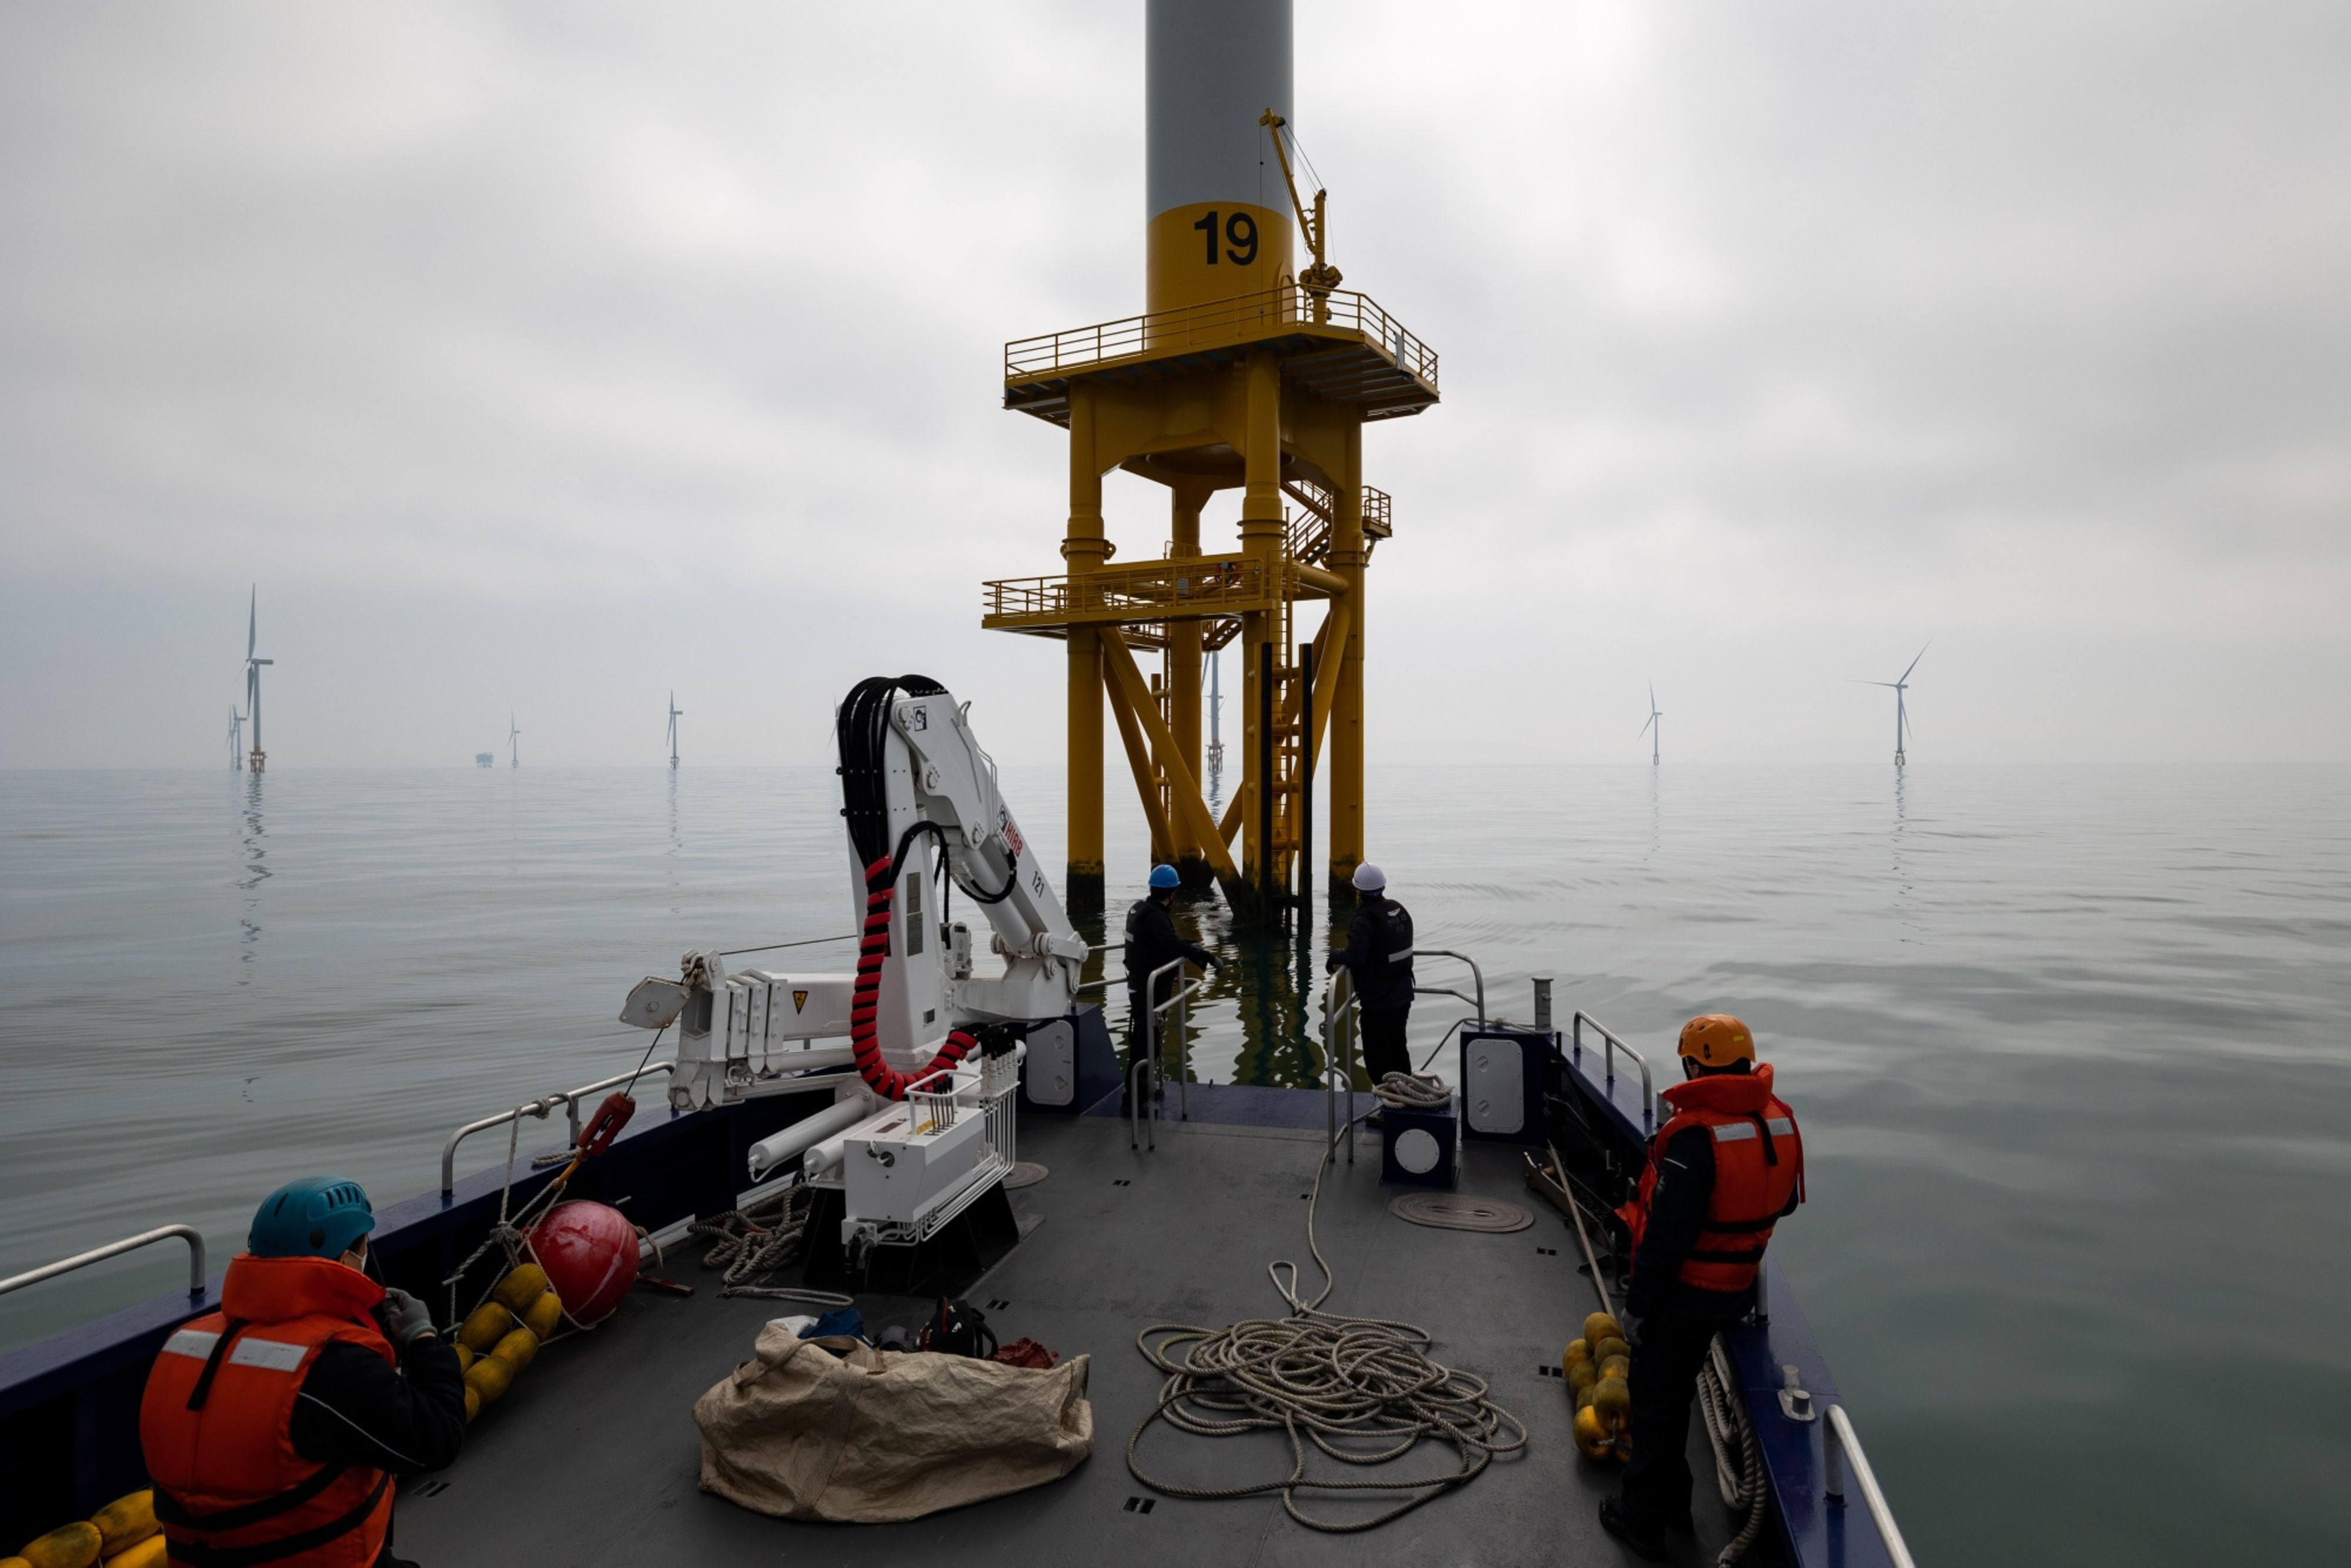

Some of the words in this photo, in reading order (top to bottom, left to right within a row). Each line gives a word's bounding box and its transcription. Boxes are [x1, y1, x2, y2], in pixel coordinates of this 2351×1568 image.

[1194, 212, 1258, 266] 19
[1005, 821, 1023, 857] HIAB
[1032, 871, 1044, 898] 121
